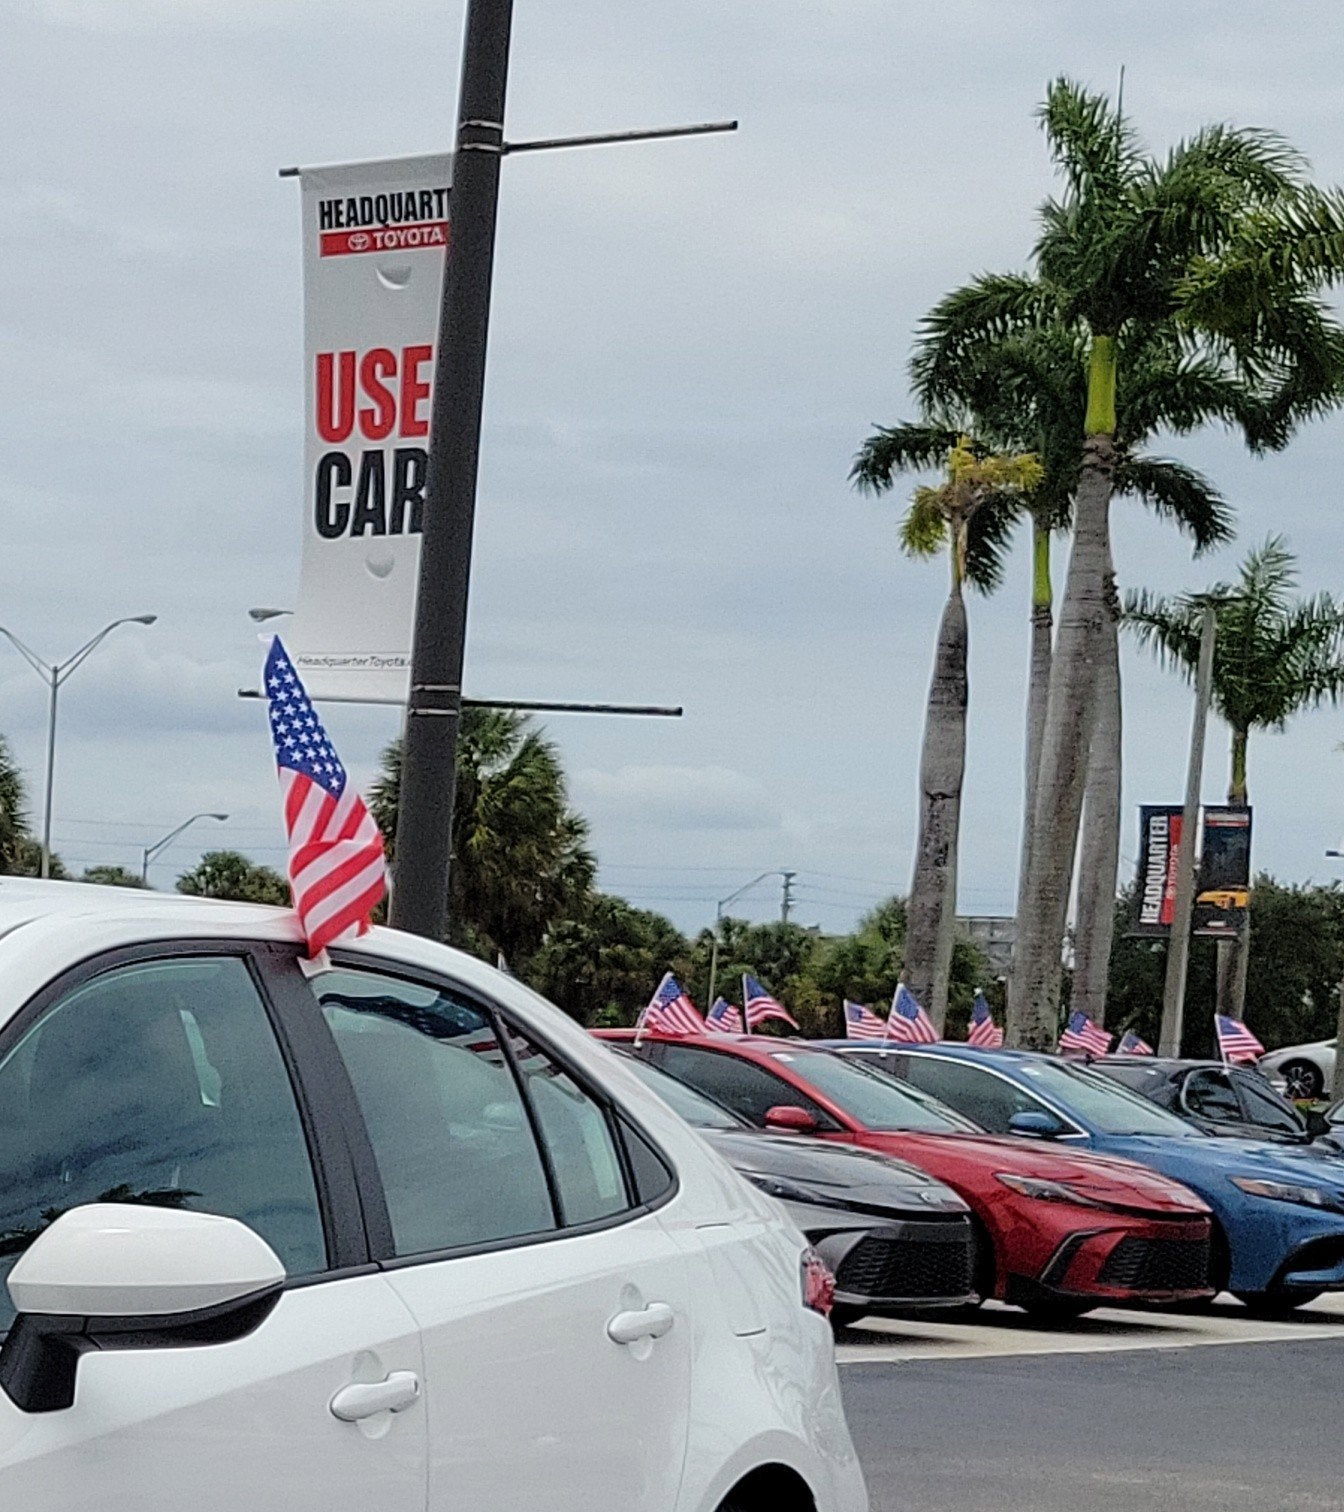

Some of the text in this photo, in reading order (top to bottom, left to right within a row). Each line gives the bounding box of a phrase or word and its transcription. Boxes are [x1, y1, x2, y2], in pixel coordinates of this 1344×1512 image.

[319, 188, 451, 229] HEADQUART
[372, 227, 444, 250] TOYOTA
[316, 344, 433, 444] USE
[315, 446, 429, 540] CAR
[1139, 815, 1169, 925] HEADQUARTER
